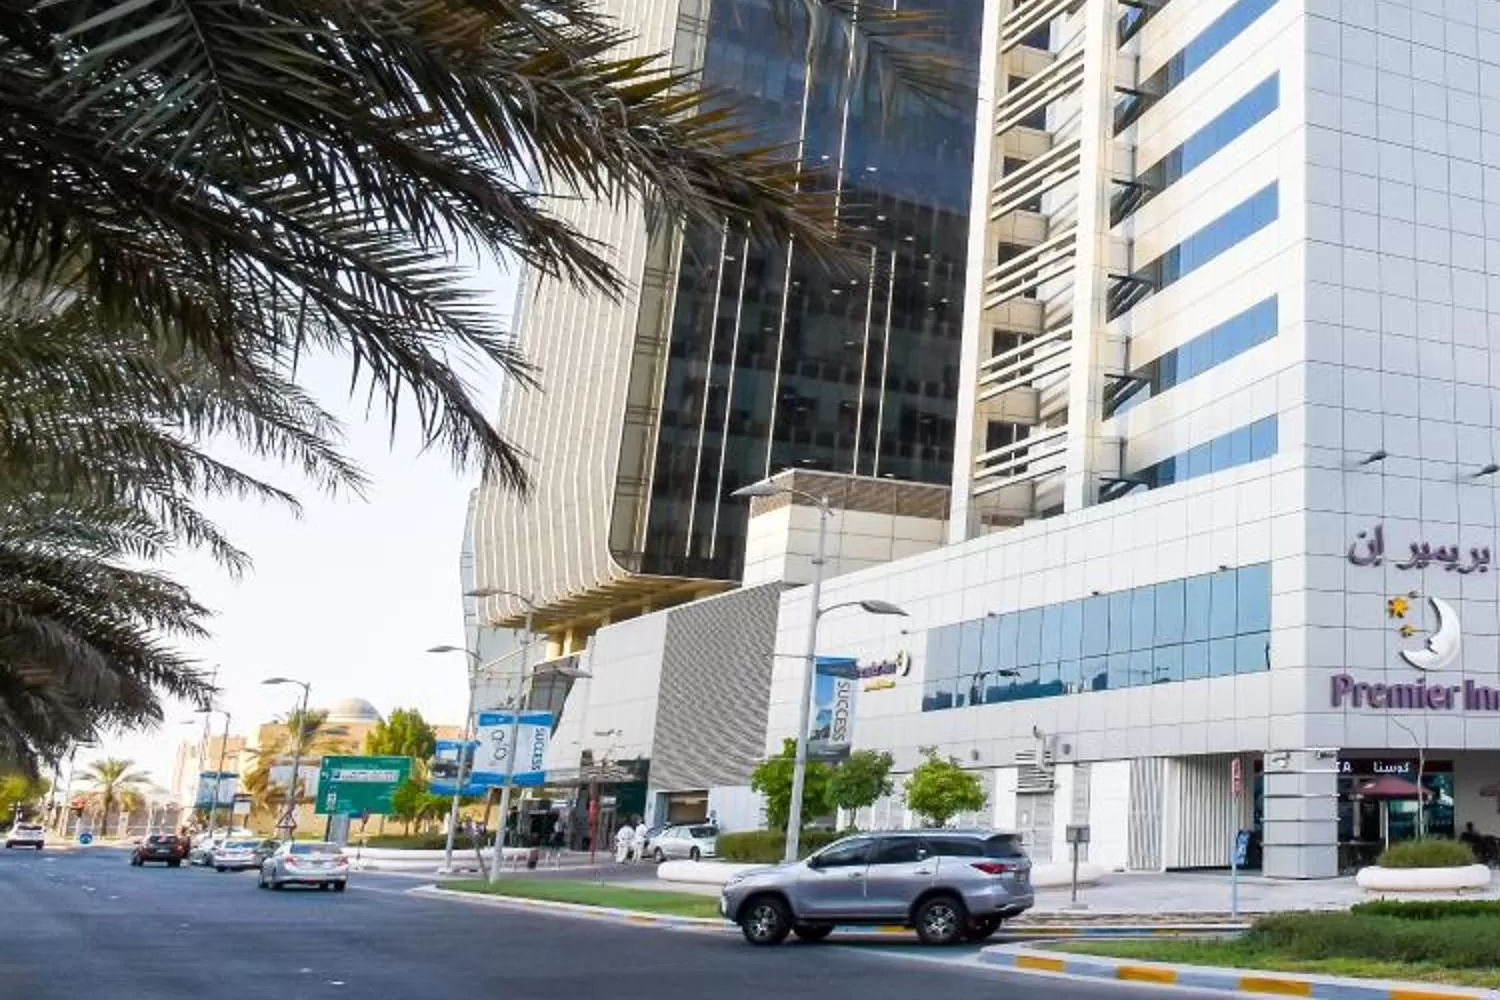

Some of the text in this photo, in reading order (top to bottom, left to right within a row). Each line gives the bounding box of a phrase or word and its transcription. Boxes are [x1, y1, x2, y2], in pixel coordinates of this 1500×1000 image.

[1348, 523, 1491, 574] بريمير إن
[831, 680, 851, 741] SUCCESS
[1330, 673, 1461, 710] Premier
